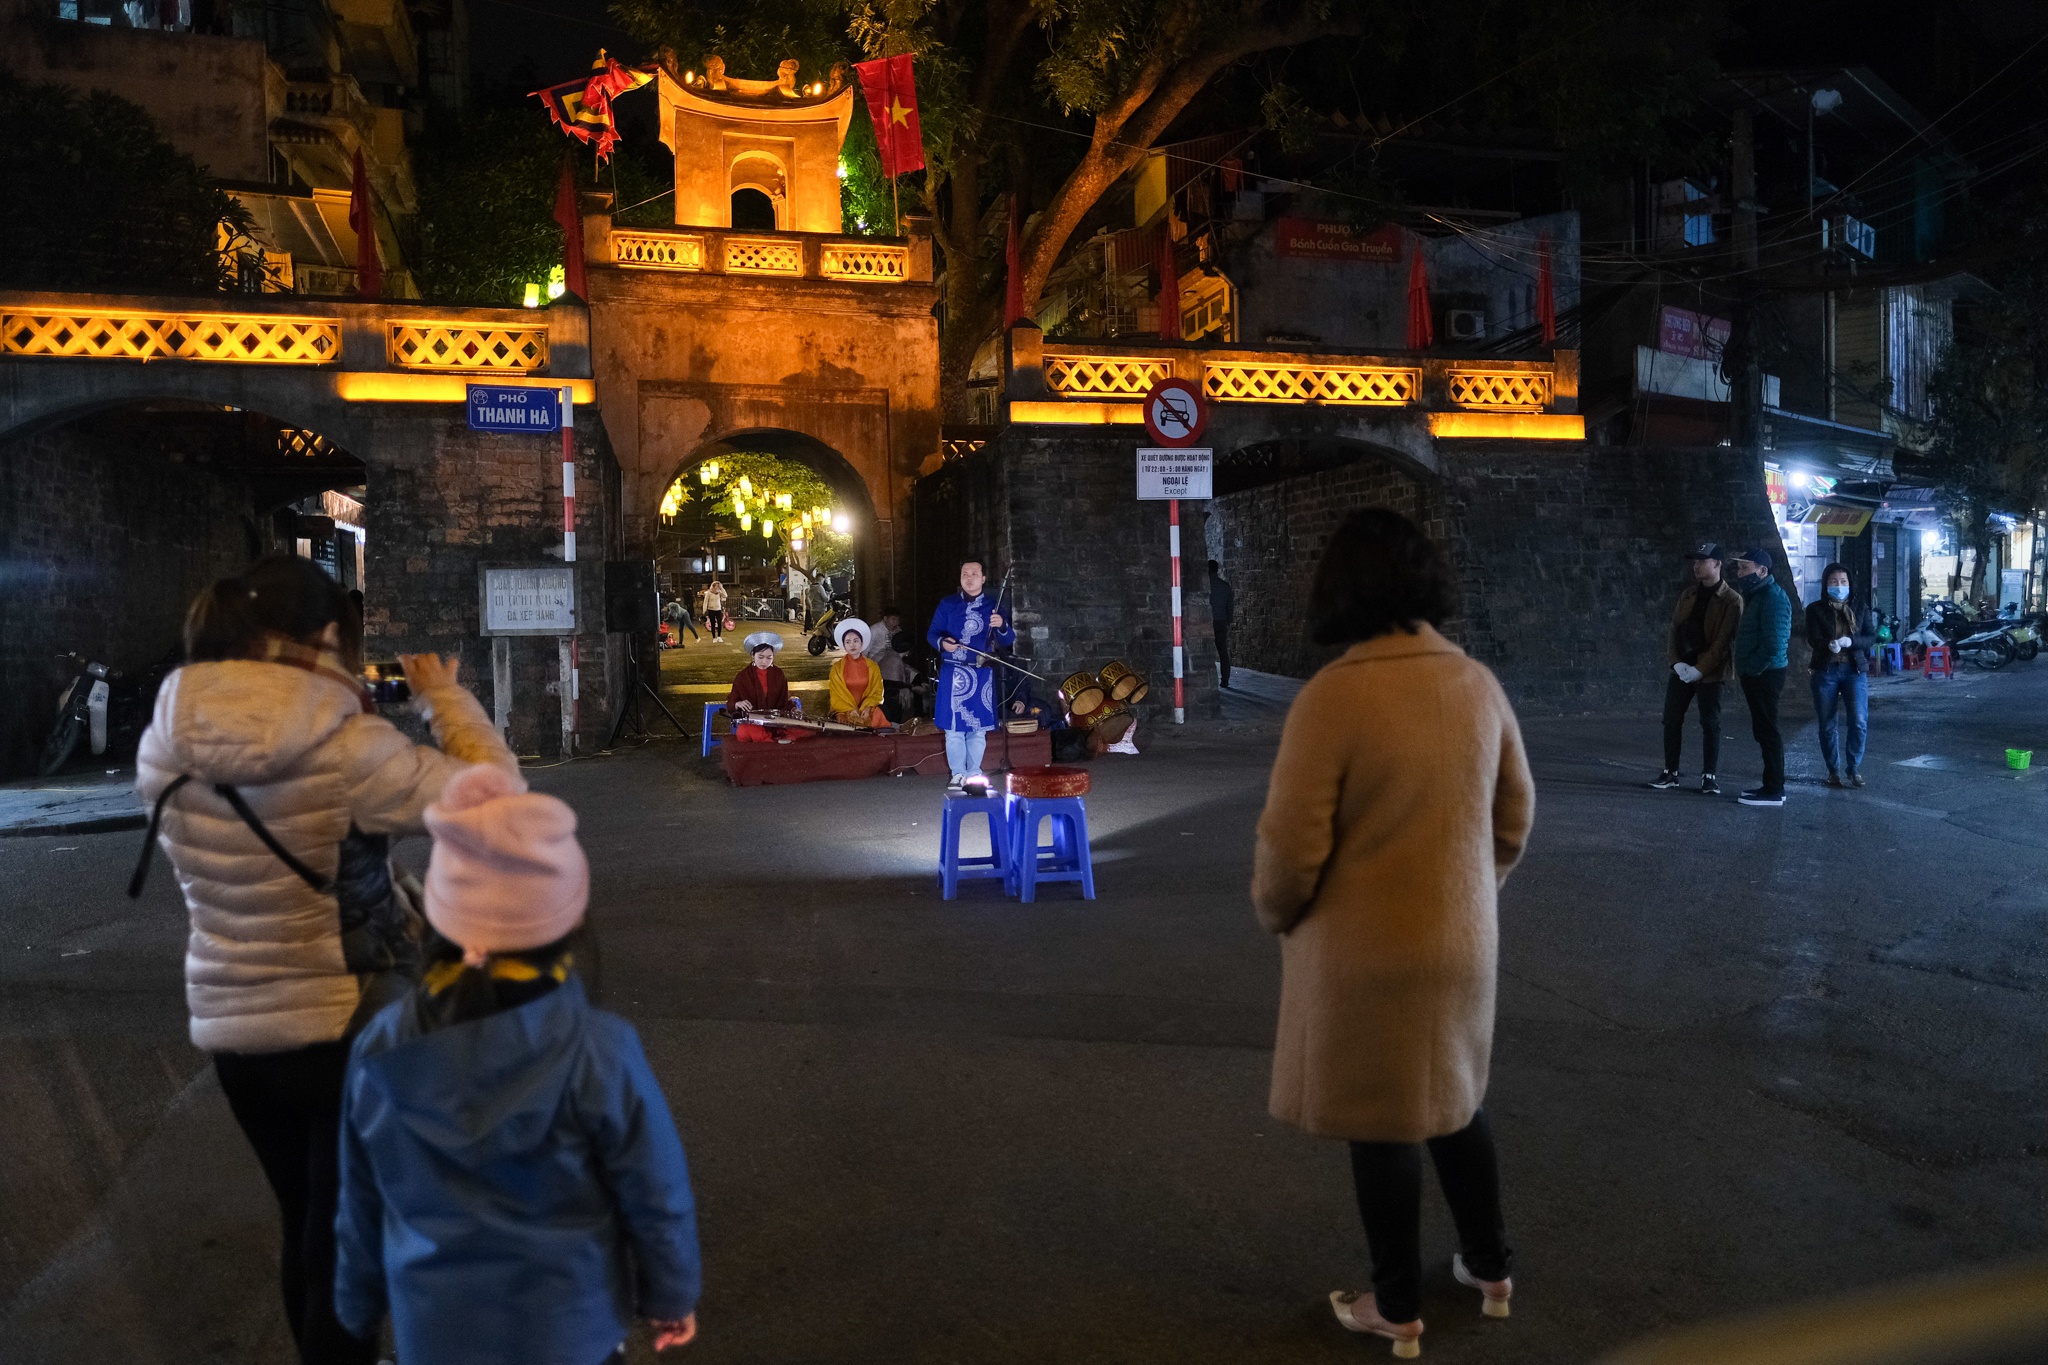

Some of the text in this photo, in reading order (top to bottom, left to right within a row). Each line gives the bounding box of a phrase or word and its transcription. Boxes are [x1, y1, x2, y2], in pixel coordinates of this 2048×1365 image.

[1290, 237, 1315, 249] Bánh
[1316, 238, 1340, 251] Cuốn
[1341, 241, 1359, 252] Gia
[499, 391, 527, 404] PHỐ
[478, 406, 549, 425] THANH HÀ
[1162, 476, 1188, 487] NGOẠI LỆ
[1164, 487, 1187, 495] Except
